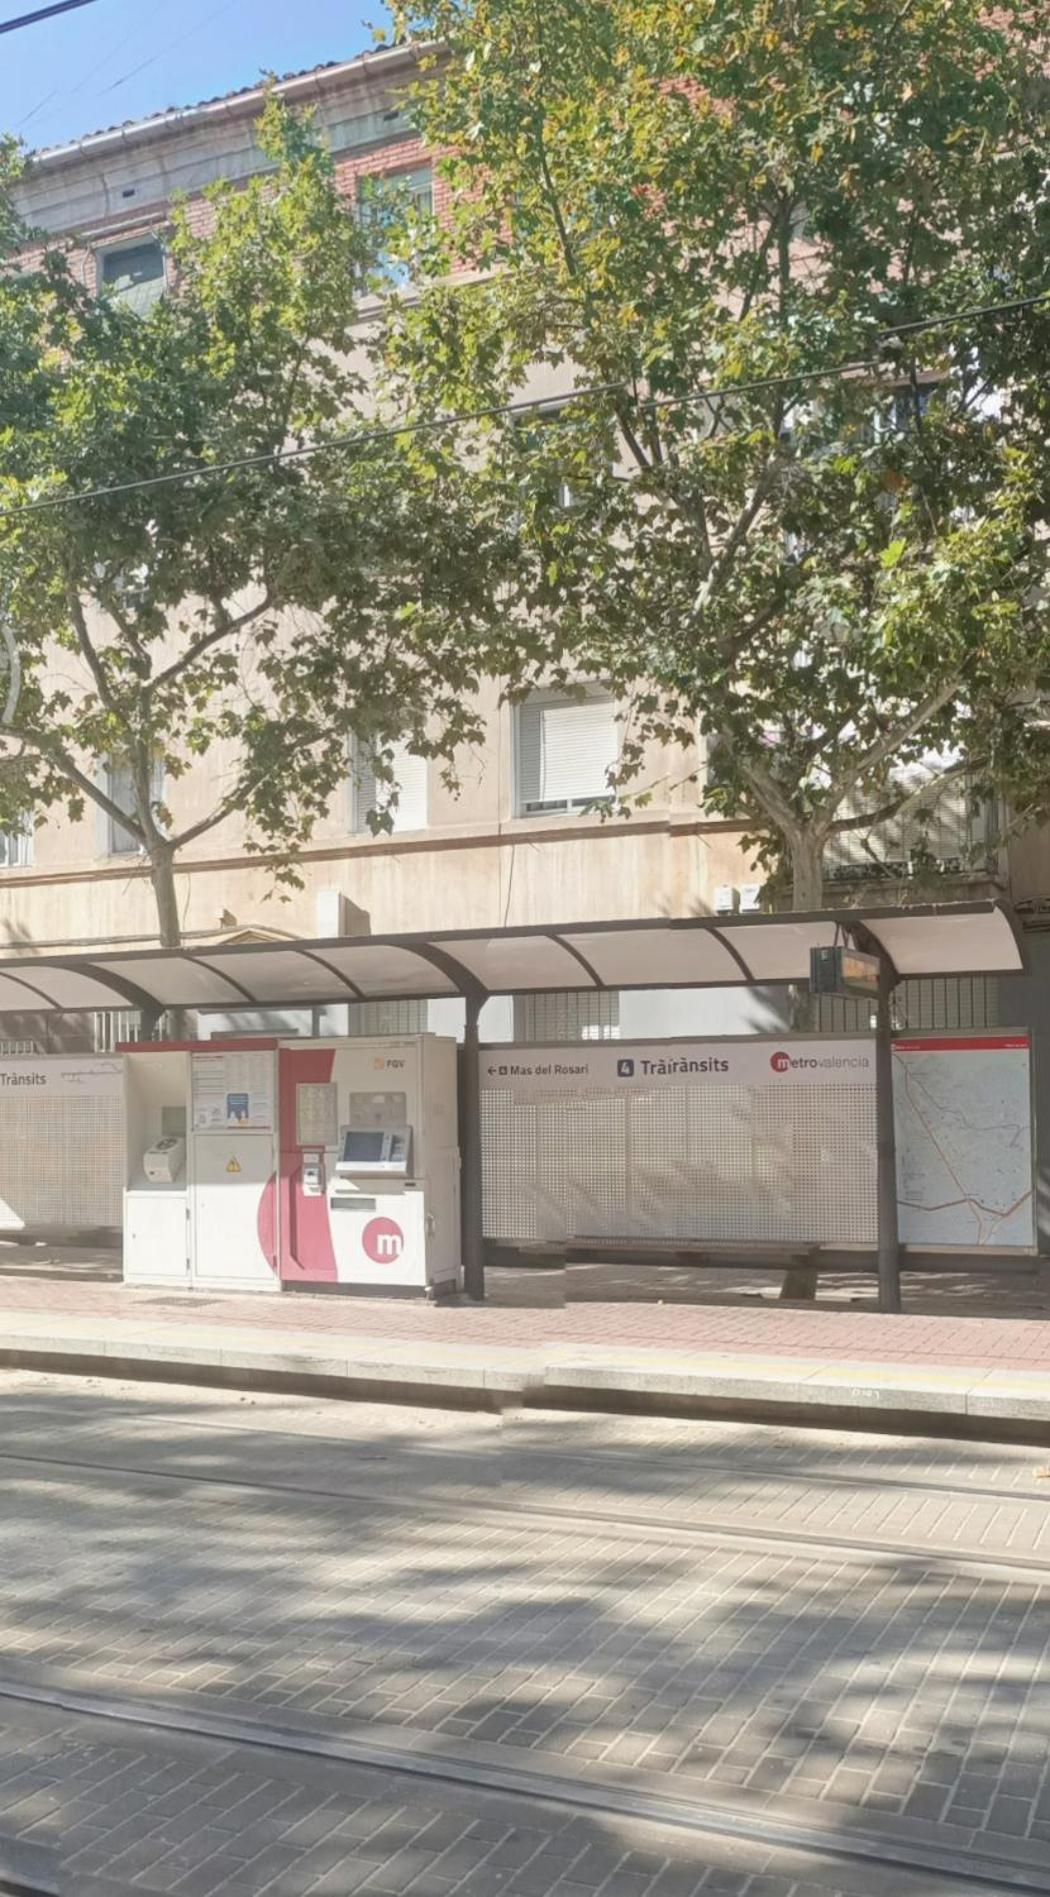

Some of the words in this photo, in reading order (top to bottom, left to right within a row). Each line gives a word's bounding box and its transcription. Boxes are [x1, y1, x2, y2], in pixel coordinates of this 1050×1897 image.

[510, 1065, 532, 1075] Mas
[535, 1064, 551, 1075] del
[555, 1064, 588, 1075] Rosari
[0, 1072, 47, 1086] Trànsits
